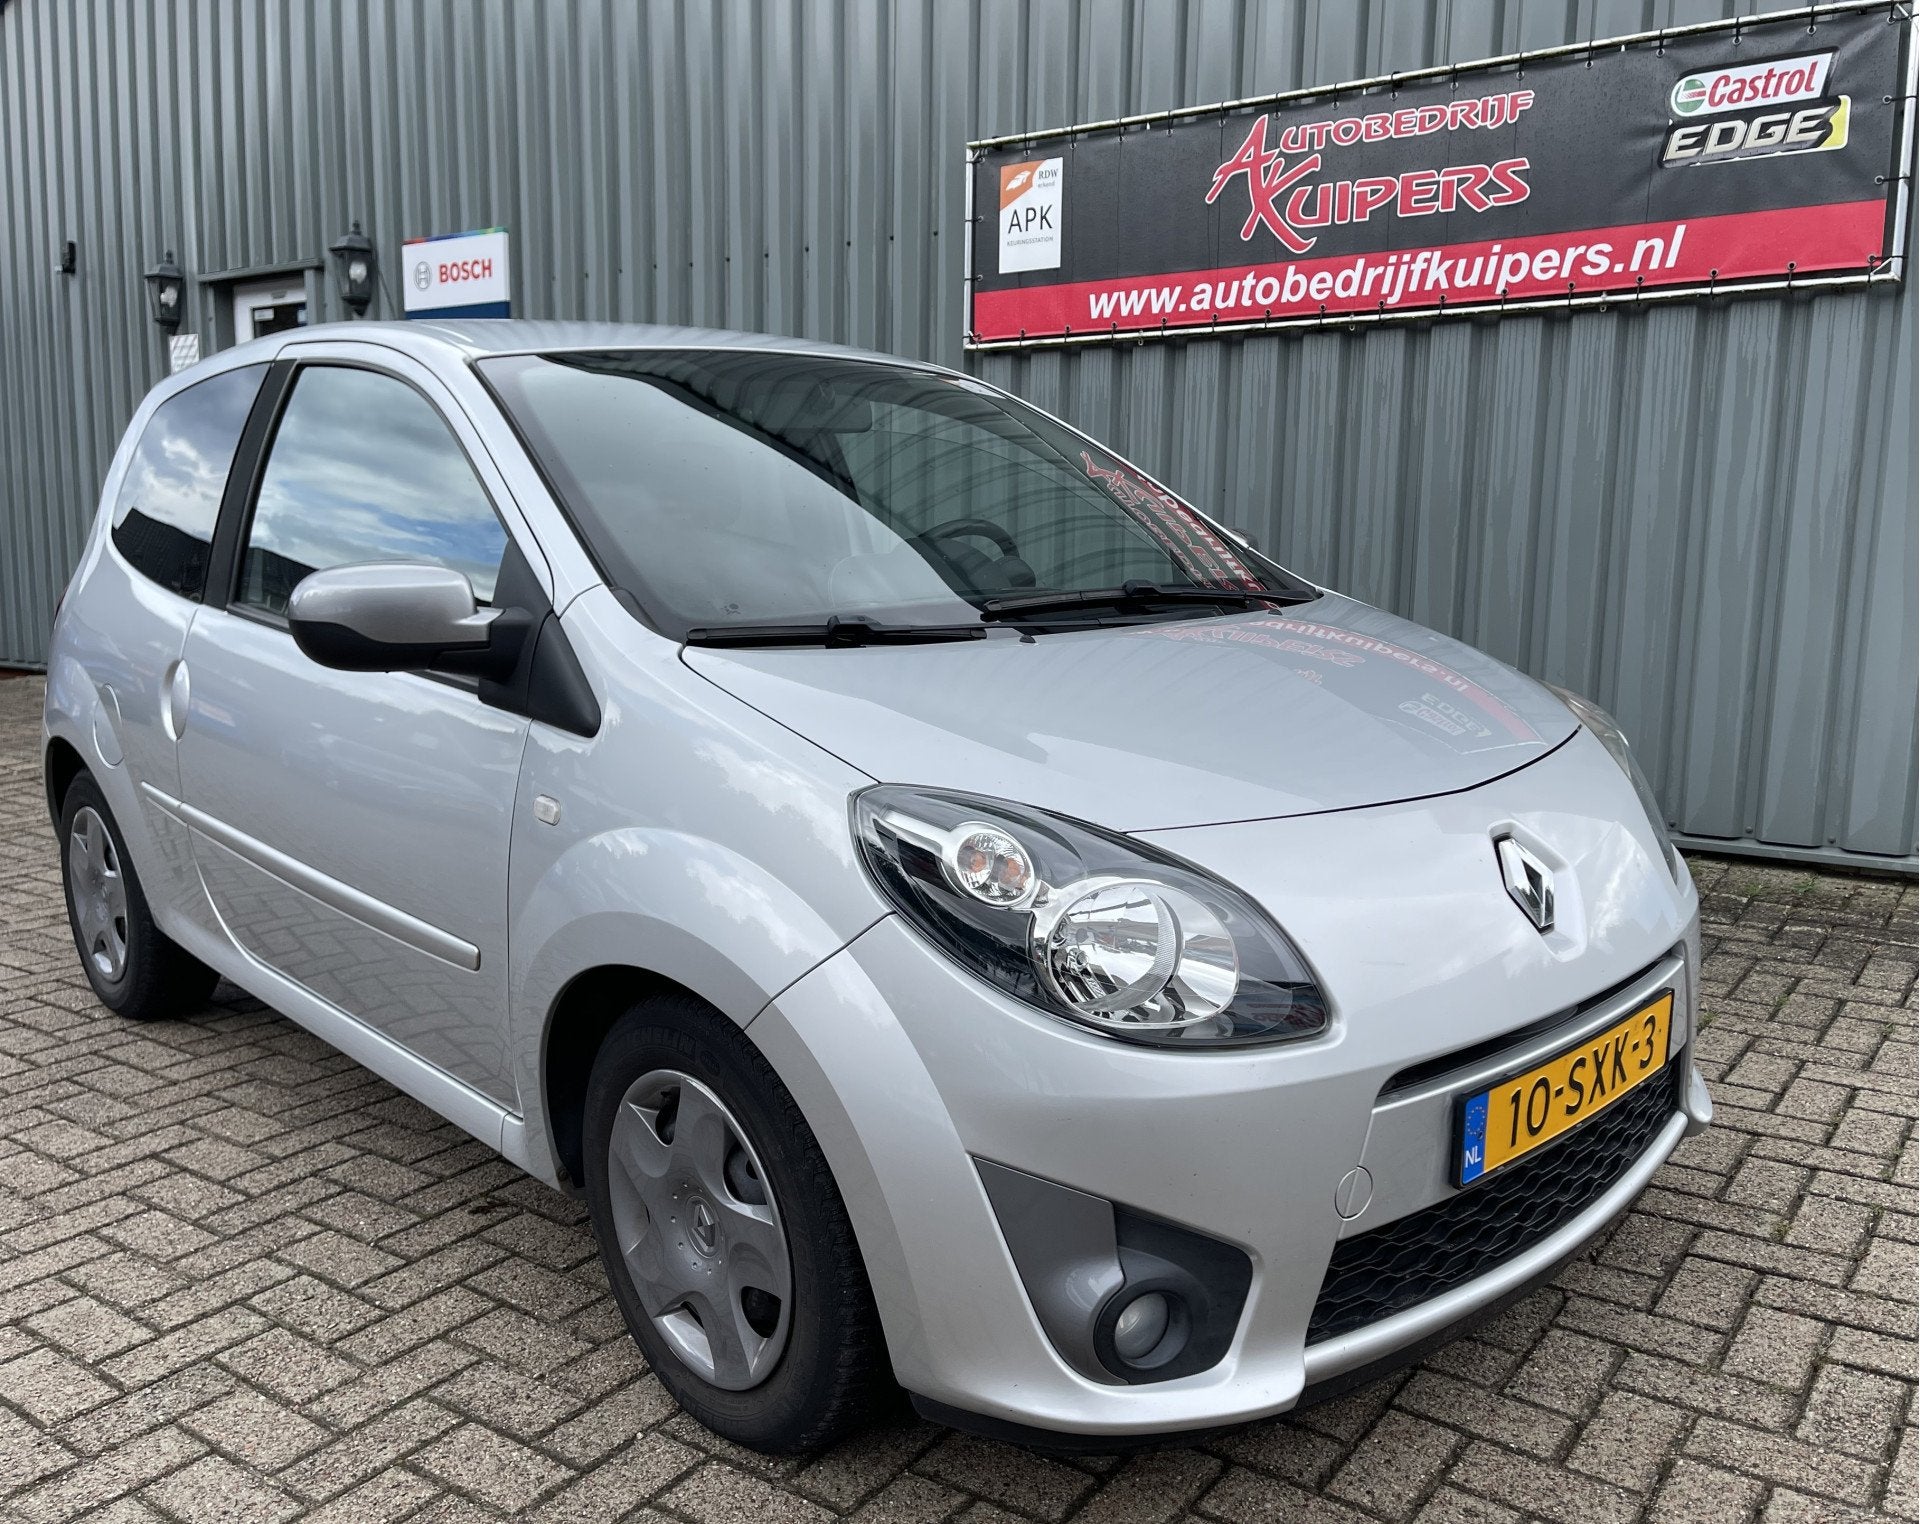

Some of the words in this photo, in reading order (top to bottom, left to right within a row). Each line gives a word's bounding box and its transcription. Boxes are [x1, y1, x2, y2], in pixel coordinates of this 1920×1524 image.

[1708, 60, 1818, 108] Castrol
[1663, 106, 1836, 161] EDGE
[1038, 169, 1058, 179] RDW
[1008, 204, 1053, 234] APK
[1240, 154, 1531, 254] KUIPERS
[1007, 237, 1054, 246] KEURINGSSTATION
[438, 258, 492, 282] BOSCH
[1089, 224, 1686, 319] www.autobedrijfkuipers.nl
[1510, 1014, 1656, 1148] 10-SXK-3
[1464, 1145, 1482, 1168] NL
